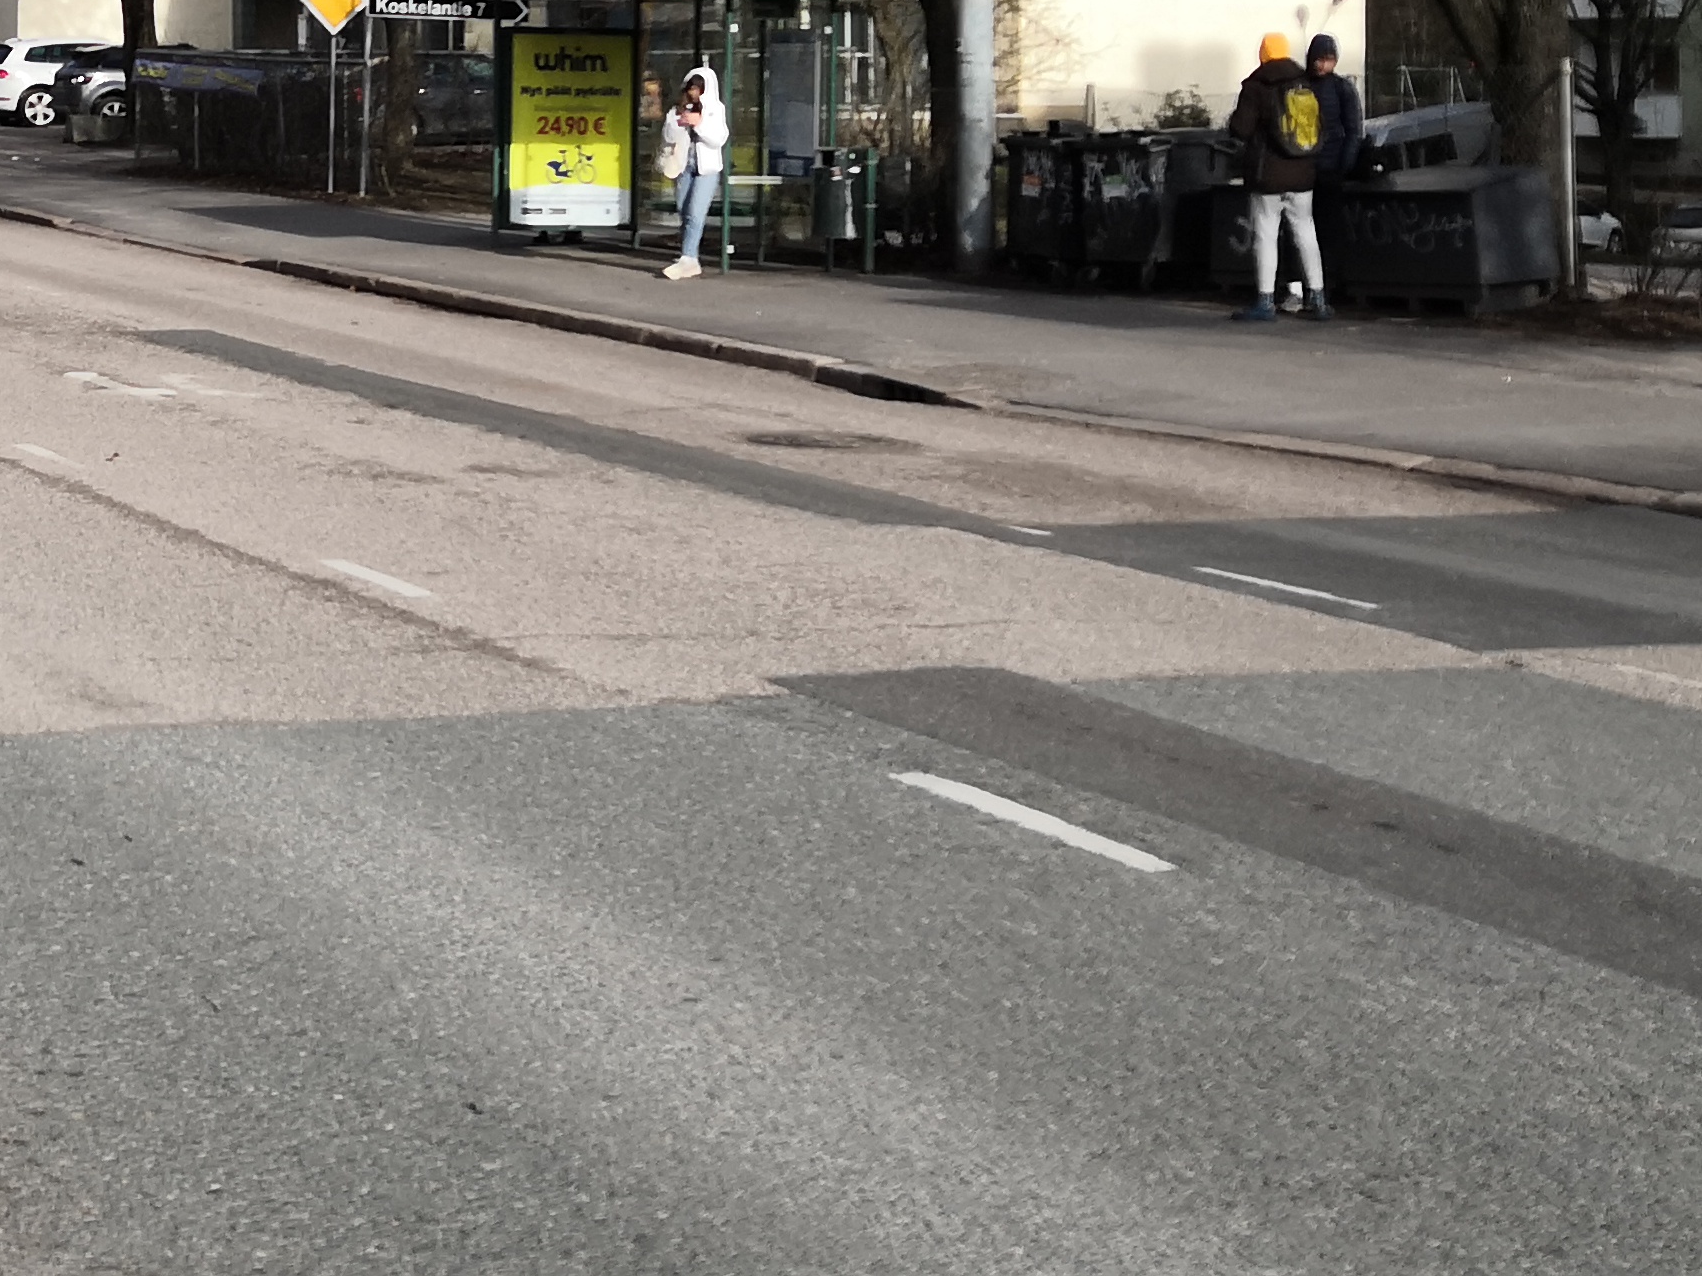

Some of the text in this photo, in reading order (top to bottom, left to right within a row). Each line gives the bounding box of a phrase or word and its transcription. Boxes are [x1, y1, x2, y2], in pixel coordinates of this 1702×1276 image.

[475, 2, 487, 17] 7
[534, 45, 609, 73] whim
[536, 115, 606, 138] 24,90 €
